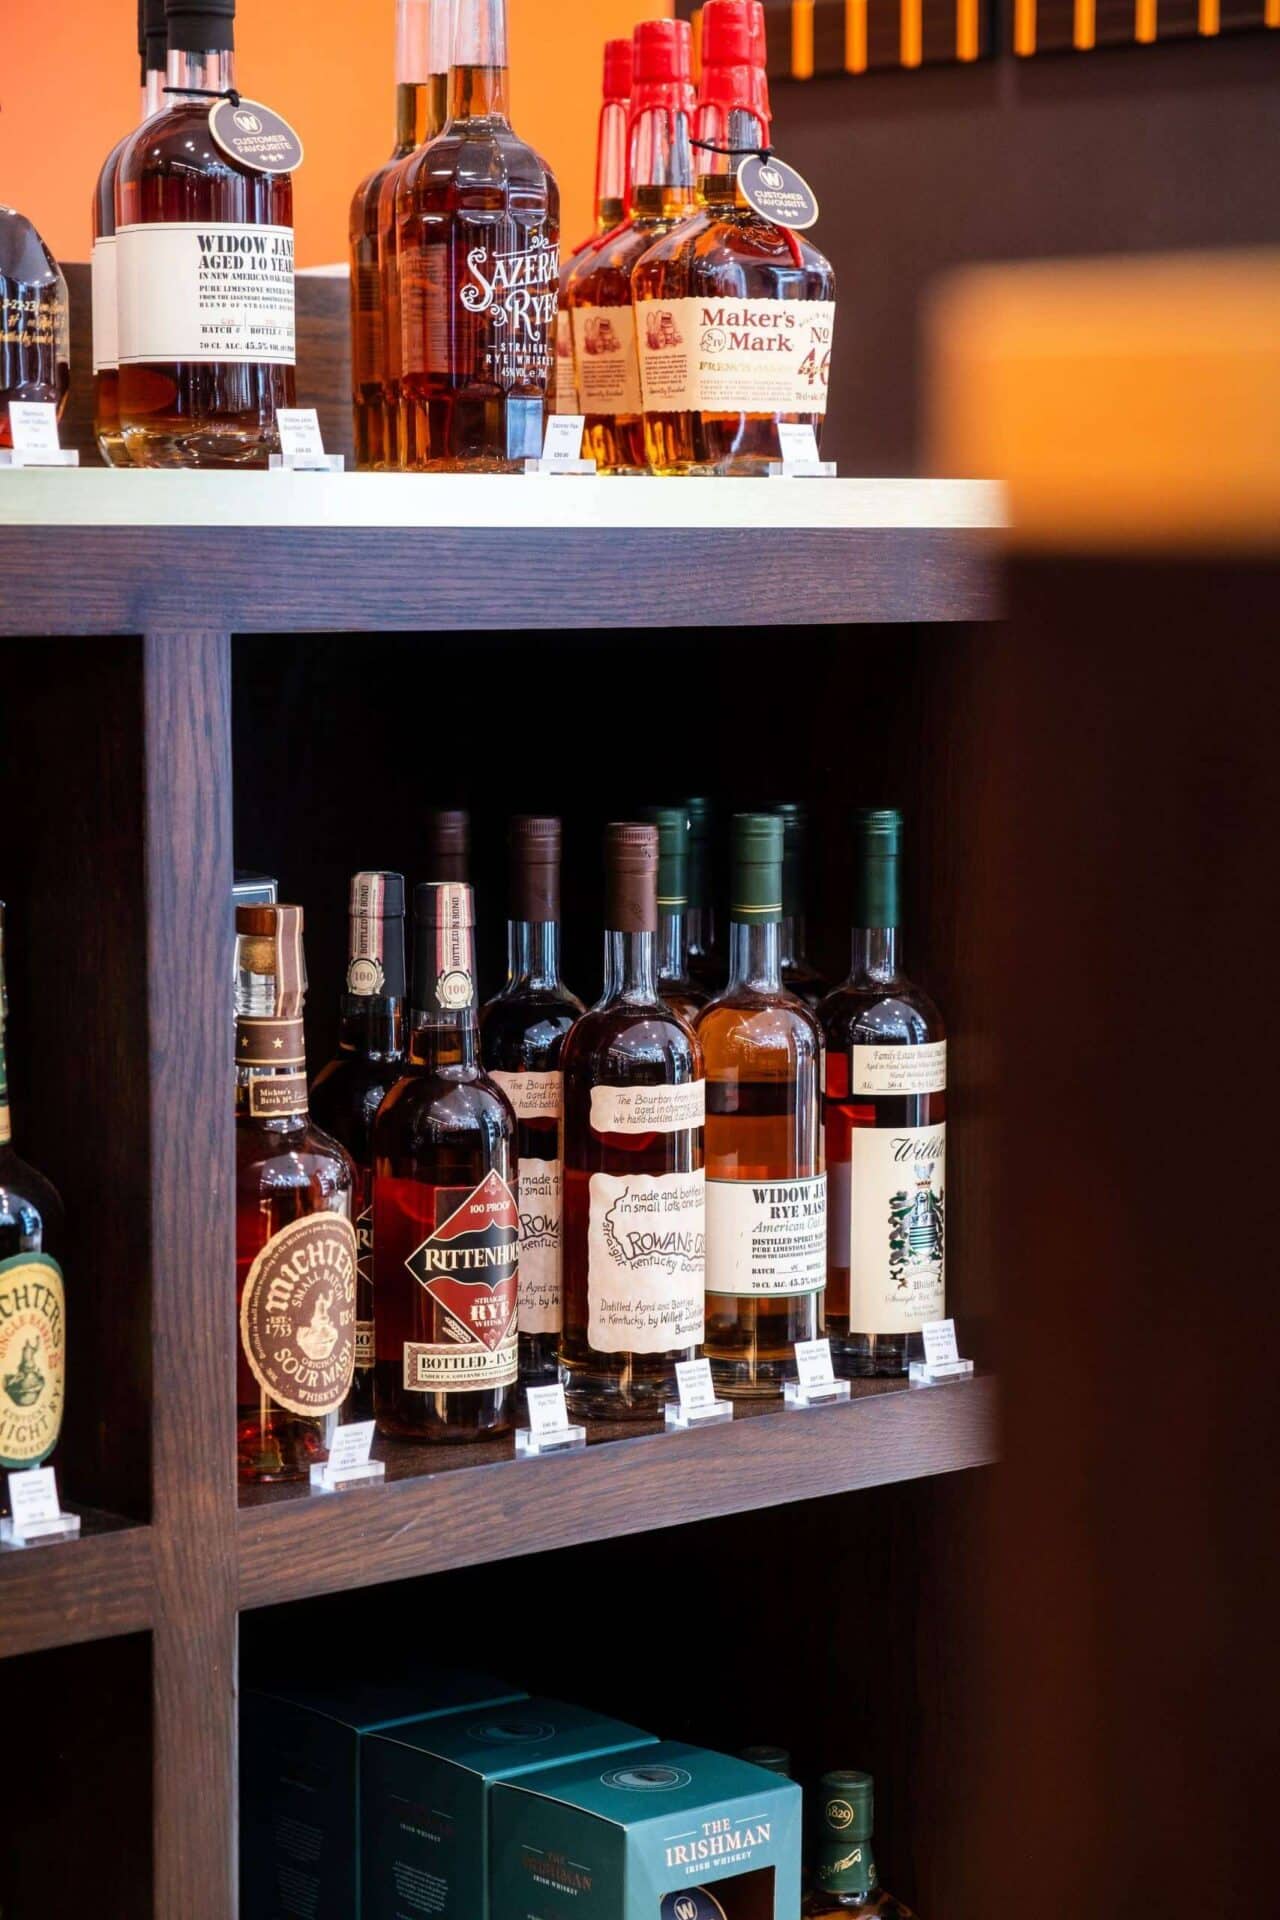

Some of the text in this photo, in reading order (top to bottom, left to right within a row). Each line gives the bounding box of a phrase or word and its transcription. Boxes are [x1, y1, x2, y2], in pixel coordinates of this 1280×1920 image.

[232, 134, 288, 146] CUSTOMER
[236, 142, 294, 153] FAVOURITE
[754, 190, 804, 201] CUSTOMER
[757, 197, 808, 209] FAVOURITE
[197, 235, 267, 254] WIDOW
[198, 256, 244, 270] AGED
[250, 256, 268, 270] 10
[199, 272, 209, 280] IN
[211, 272, 229, 280] NEW
[231, 272, 269, 282] AMERICAN
[699, 307, 795, 329] Maker's
[202, 326, 233, 335] BATCH
[728, 331, 793, 353] Mark
[354, 972, 373, 982] 100
[448, 984, 466, 995] 100
[508, 1079, 522, 1090] The
[616, 1094, 632, 1105] The
[635, 1093, 671, 1105] Bourbon
[634, 1105, 655, 1116] aged
[522, 1175, 551, 1188] made
[525, 1183, 551, 1196] small
[631, 1190, 660, 1203] made
[661, 1189, 678, 1201] and
[752, 1185, 811, 1204] WIDOW
[470, 1200, 511, 1215] 100 PROOF
[620, 1199, 632, 1213] in
[634, 1200, 660, 1213] small
[770, 1205, 799, 1219] RYE
[752, 1219, 805, 1233] American
[752, 1237, 792, 1246] DISTILLED
[630, 1256, 678, 1276] kentucky
[752, 1267, 775, 1275] BATCH
[291, 1268, 345, 1308] SMALL BATCH
[539, 1295, 550, 1310] by
[635, 1299, 656, 1315] Aged
[471, 1302, 510, 1322] RYE
[600, 1314, 606, 1324] in
[648, 1312, 659, 1329] by
[273, 1347, 319, 1388] SOUR
[321, 1339, 353, 1387] MASH
[301, 1354, 337, 1370] ORIGINAL
[421, 1357, 487, 1369] BOTTLED
[298, 1384, 340, 1402] WHISKEY
[828, 1806, 851, 1822] 1829
[702, 1818, 731, 1834] THE
[666, 1824, 771, 1867] IRISHMAN
[686, 1852, 752, 1876] IRISH WHISKEY
